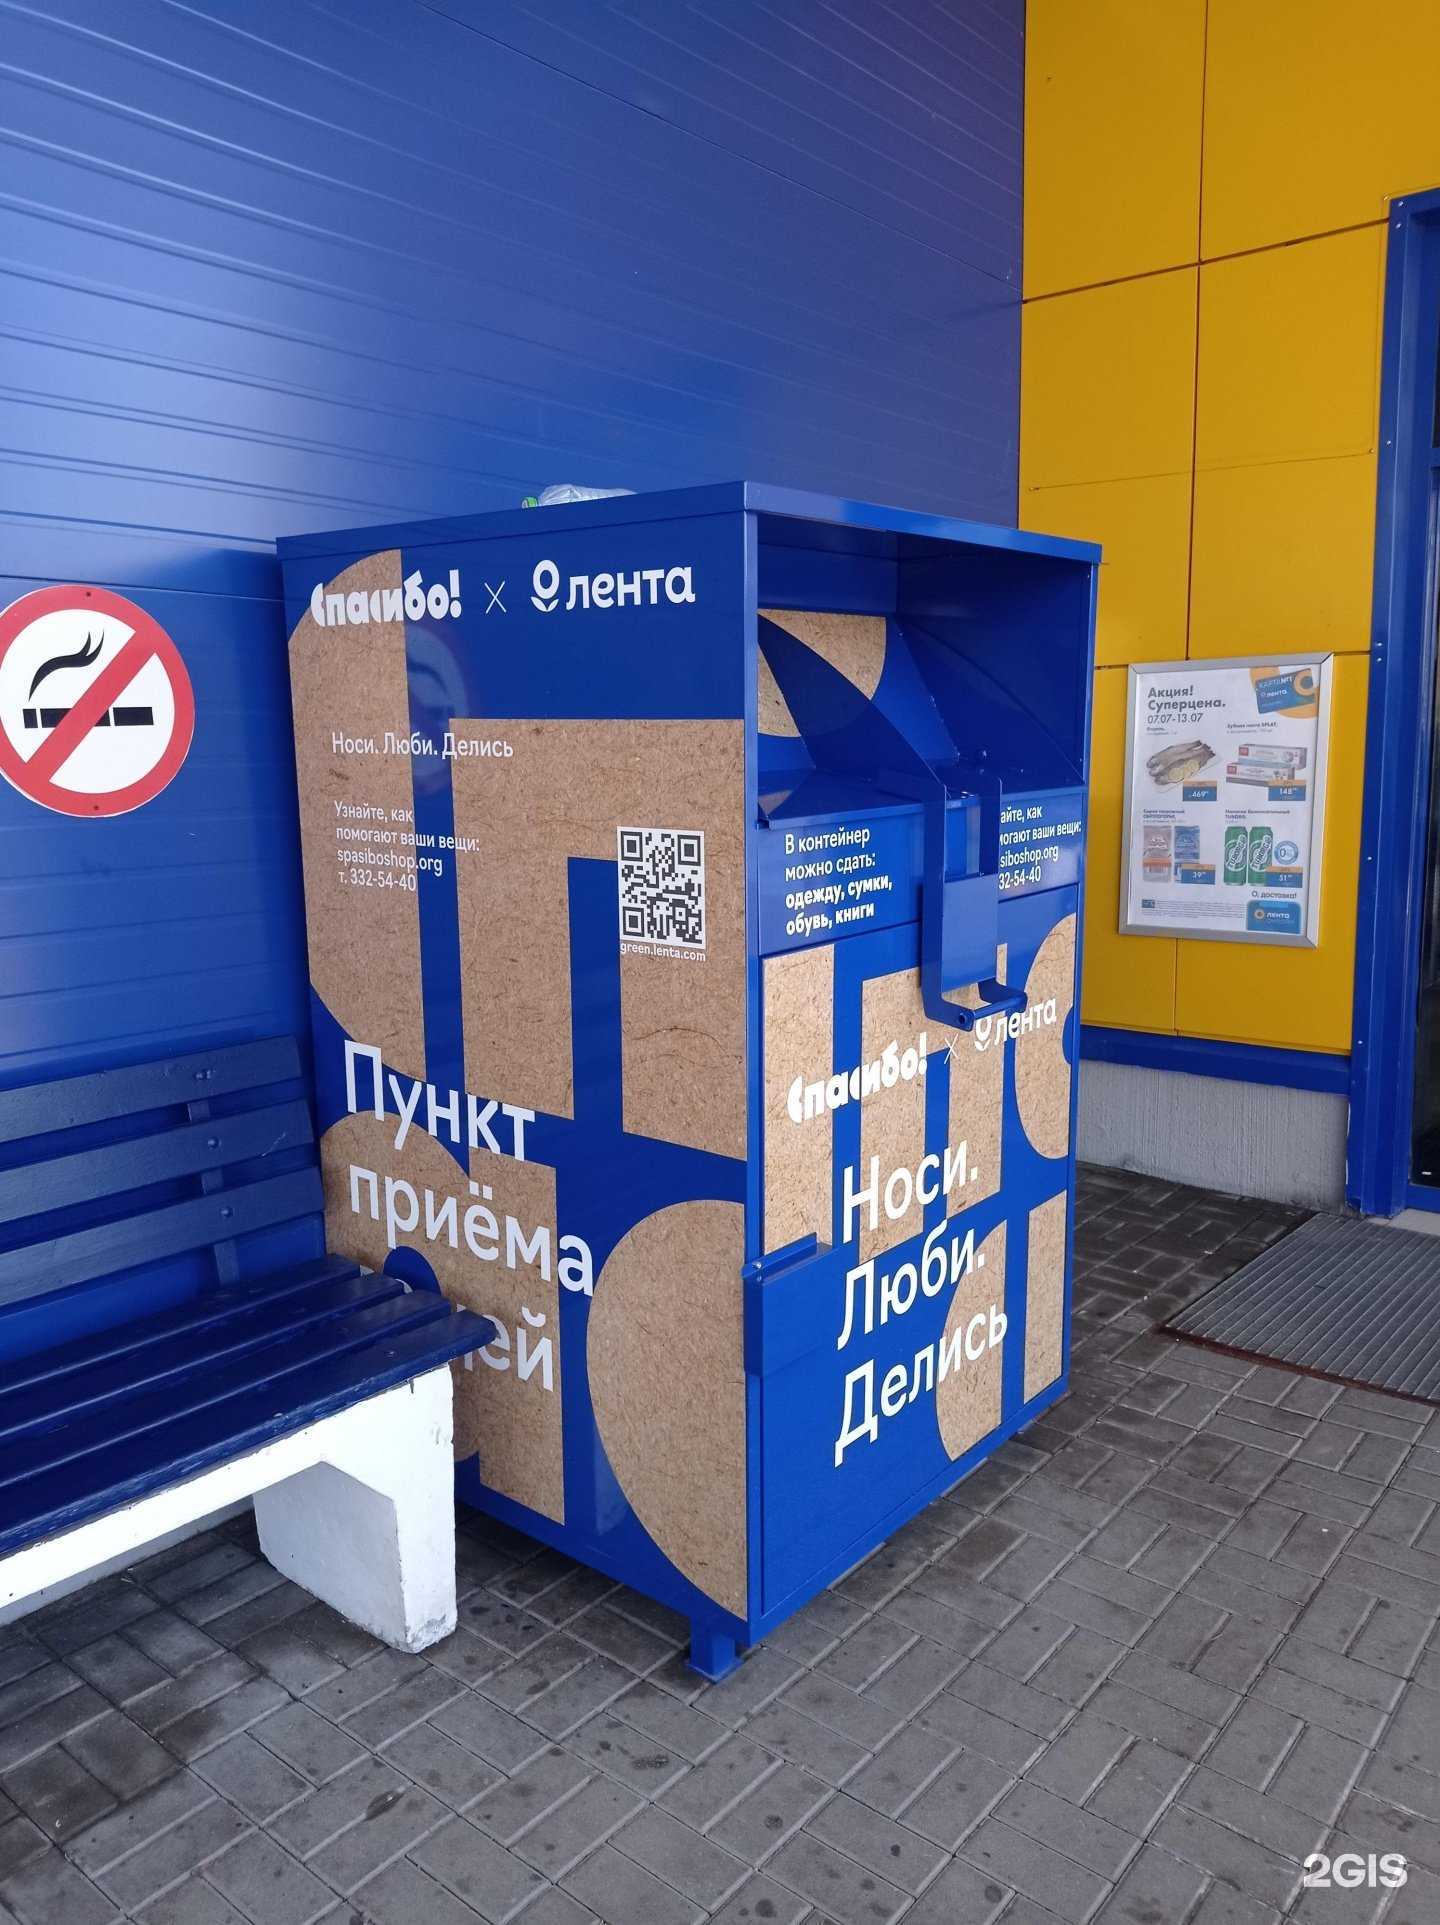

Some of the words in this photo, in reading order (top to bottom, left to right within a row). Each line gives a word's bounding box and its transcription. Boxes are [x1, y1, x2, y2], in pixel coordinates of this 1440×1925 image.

[311, 569, 462, 627] Спасибо!
[1147, 685, 1194, 699] Акция!
[1147, 699, 1226, 713] Суперцена.
[1147, 712, 1204, 724] 07.07-13.07
[331, 731, 379, 755] Носи.
[382, 731, 438, 756] Люби.
[442, 732, 514, 759] Делись
[334, 800, 388, 823] Узнайте,
[391, 807, 414, 823] как
[1027, 806, 1042, 819] как
[336, 827, 397, 844] помогают
[400, 832, 435, 848] ваши
[438, 835, 480, 853] вещи:
[785, 833, 795, 854] В
[798, 827, 870, 852] контейнер
[1032, 825, 1055, 840] ваши
[1057, 820, 1081, 836] вещи:
[337, 848, 443, 877] spasiboshop.org
[785, 860, 833, 882] можно
[836, 853, 876, 874] сдать:
[350, 868, 416, 892] 332-54-40
[785, 884, 845, 910] одежду,
[847, 875, 893, 900] сумки,
[1260, 891, 1297, 899] доставка!
[786, 912, 833, 937] обувь,
[835, 903, 874, 924] книги
[620, 942, 706, 962] green.lenta.com
[787, 1031, 928, 1124] Спасибо!
[344, 1039, 535, 1162] Пункт
[841, 1140, 979, 1245] Носи.
[349, 1164, 593, 1297] приёма
[837, 1219, 985, 1351] Люби.
[834, 1301, 1008, 1468] Делись
